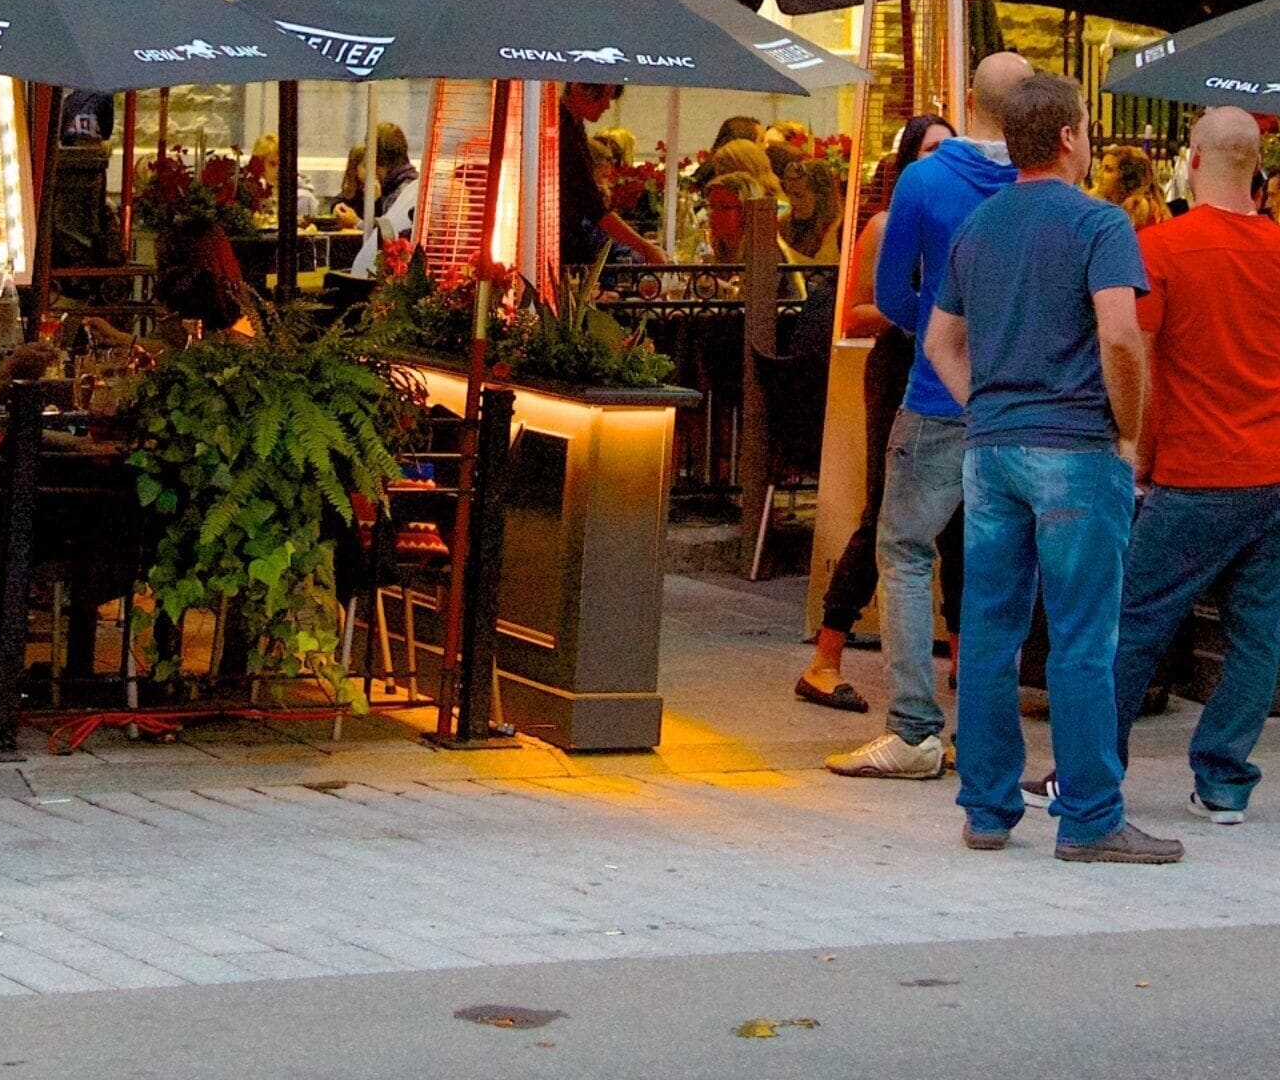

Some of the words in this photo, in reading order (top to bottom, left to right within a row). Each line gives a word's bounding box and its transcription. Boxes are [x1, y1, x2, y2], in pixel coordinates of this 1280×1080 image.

[499, 47, 568, 63] CHEVAL
[635, 54, 696, 68] BLANC
[1205, 77, 1260, 94] CHEVAL
